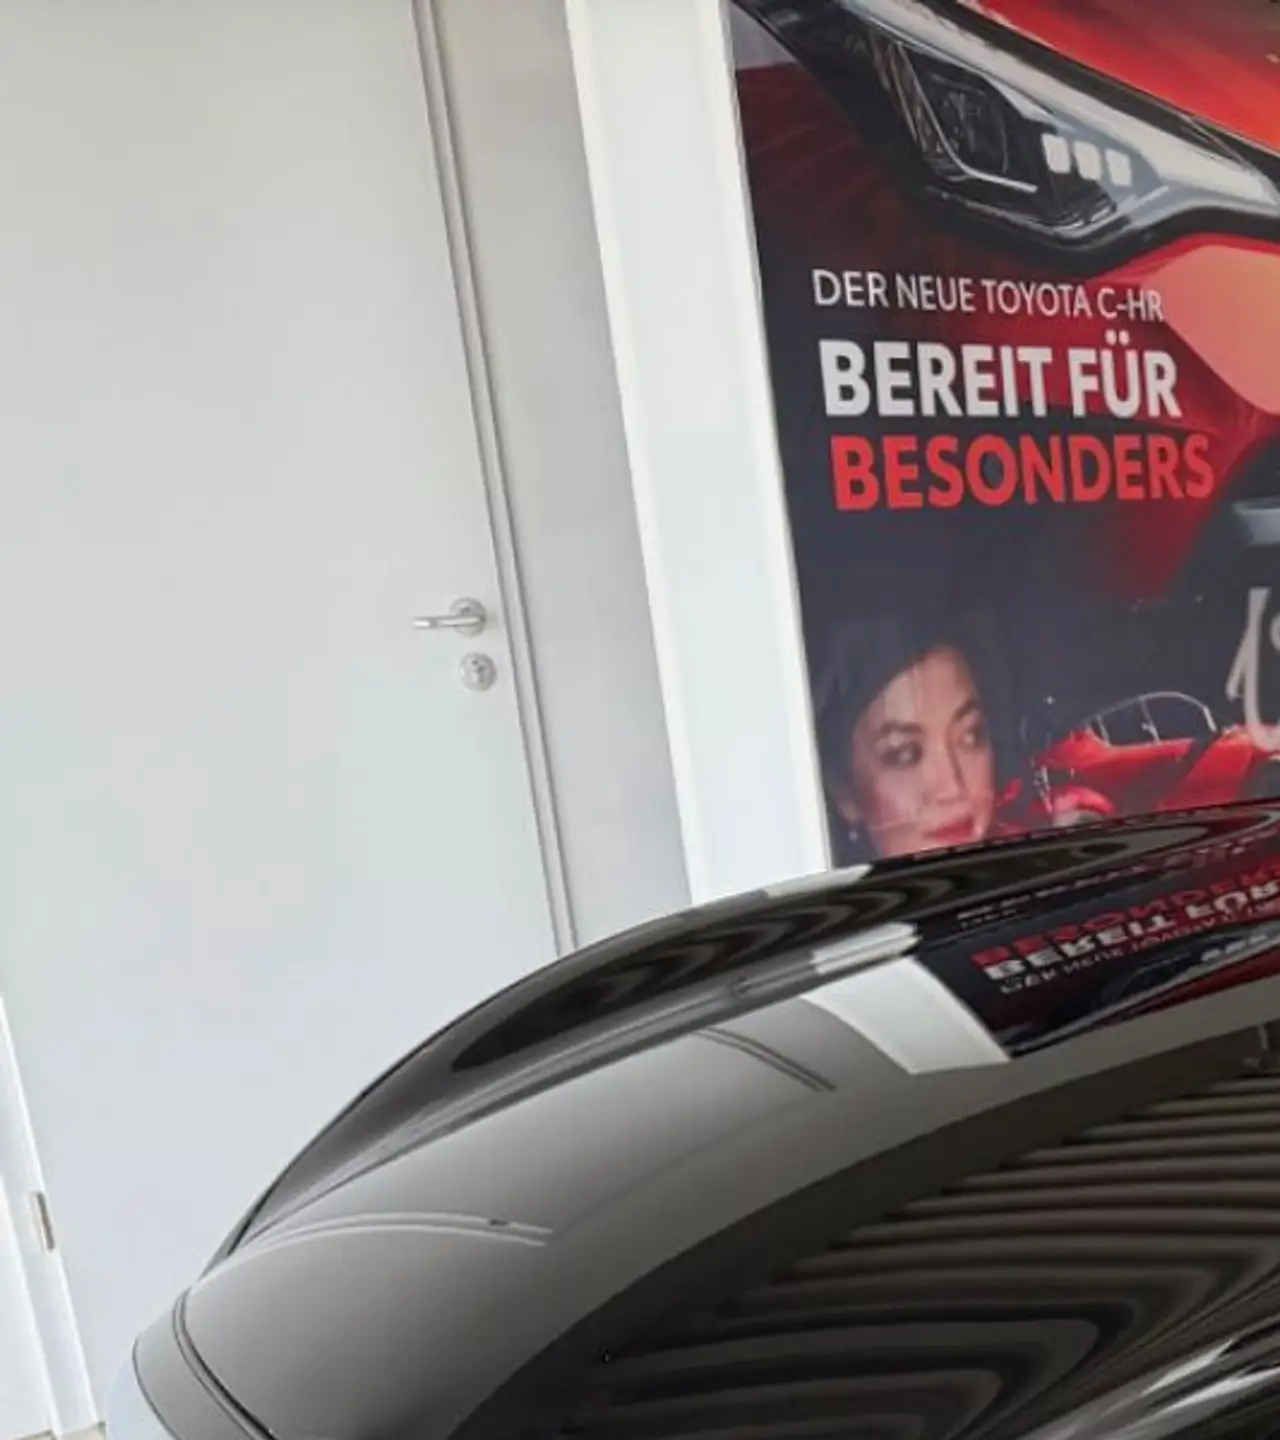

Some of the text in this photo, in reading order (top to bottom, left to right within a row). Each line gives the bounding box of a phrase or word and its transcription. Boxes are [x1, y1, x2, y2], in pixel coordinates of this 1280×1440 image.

[812, 269, 1165, 323] DER NEUE TOYOTA C-HR
[818, 329, 1182, 418] BEREIT FÜR
[830, 433, 1214, 511] BESONDERS
